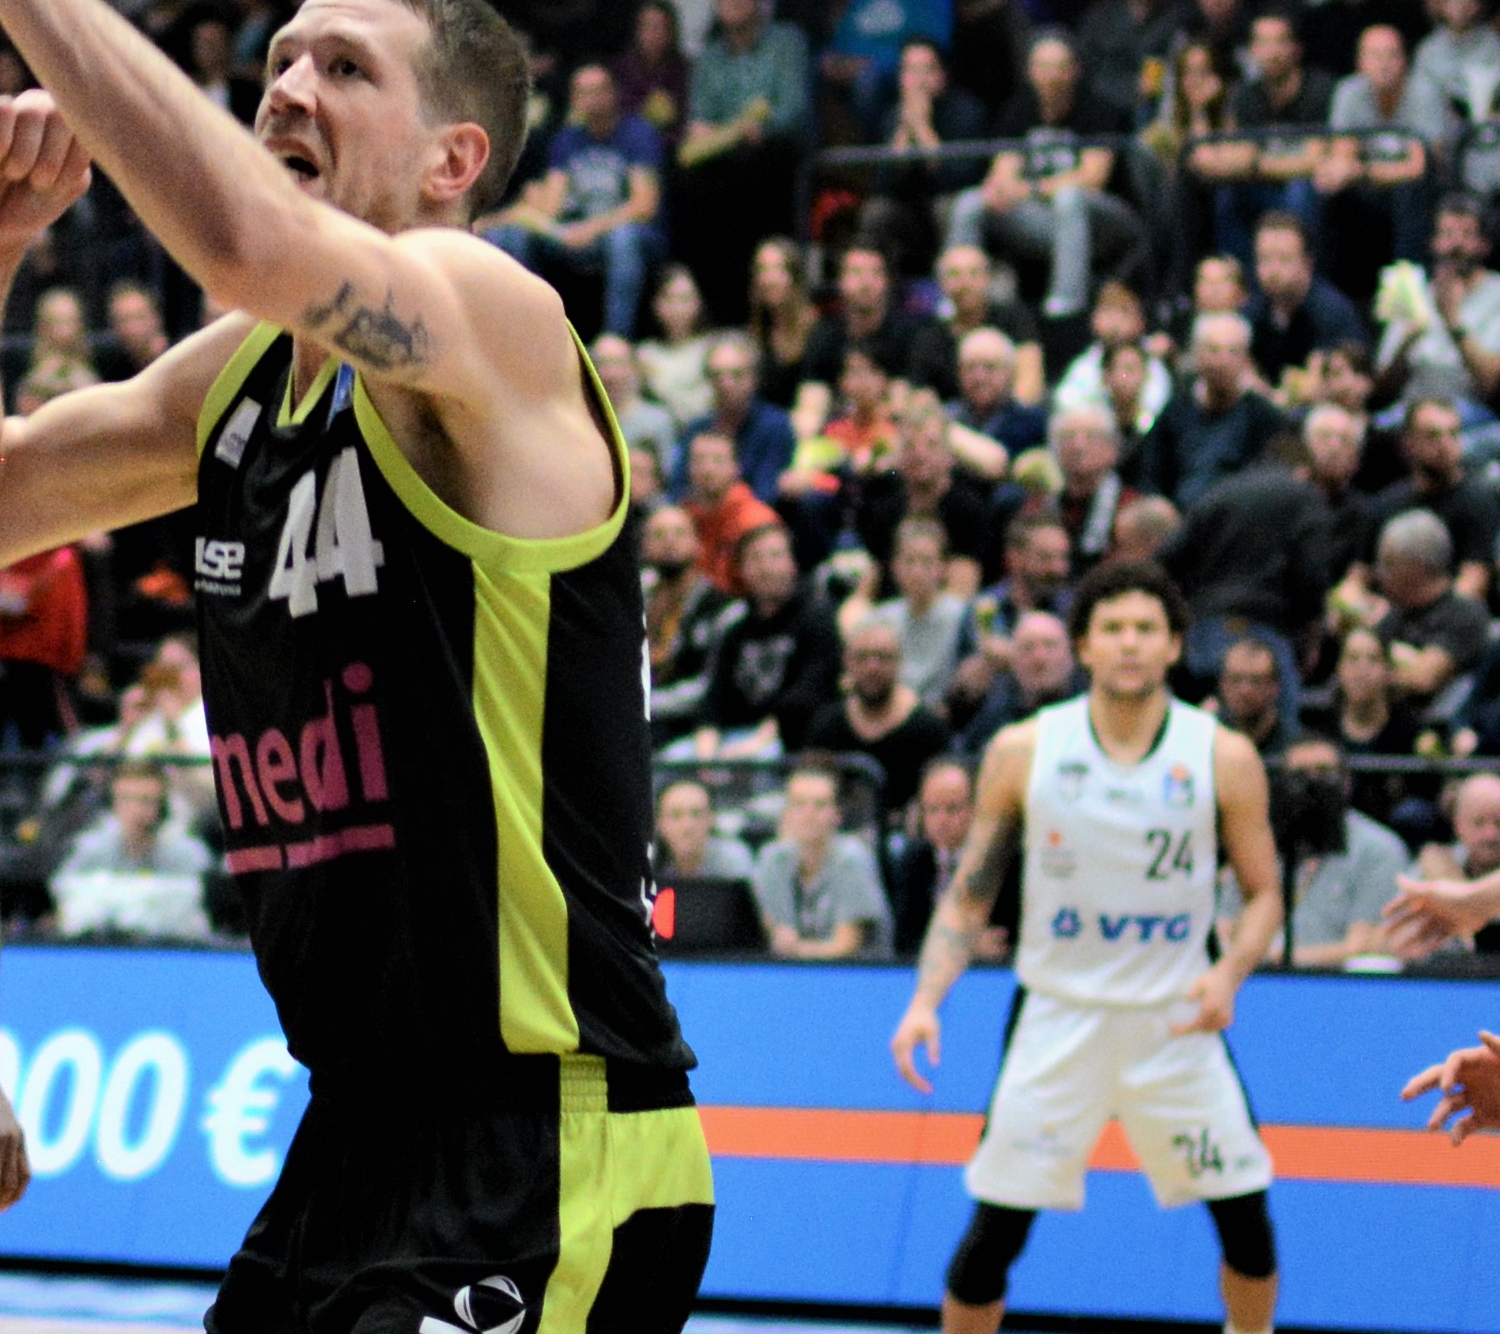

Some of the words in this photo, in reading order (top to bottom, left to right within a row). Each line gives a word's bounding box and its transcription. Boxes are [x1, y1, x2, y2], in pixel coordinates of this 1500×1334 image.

[268, 445, 387, 618] 44
[1145, 828, 1194, 882] 24
[1098, 912, 1192, 944] VTG
